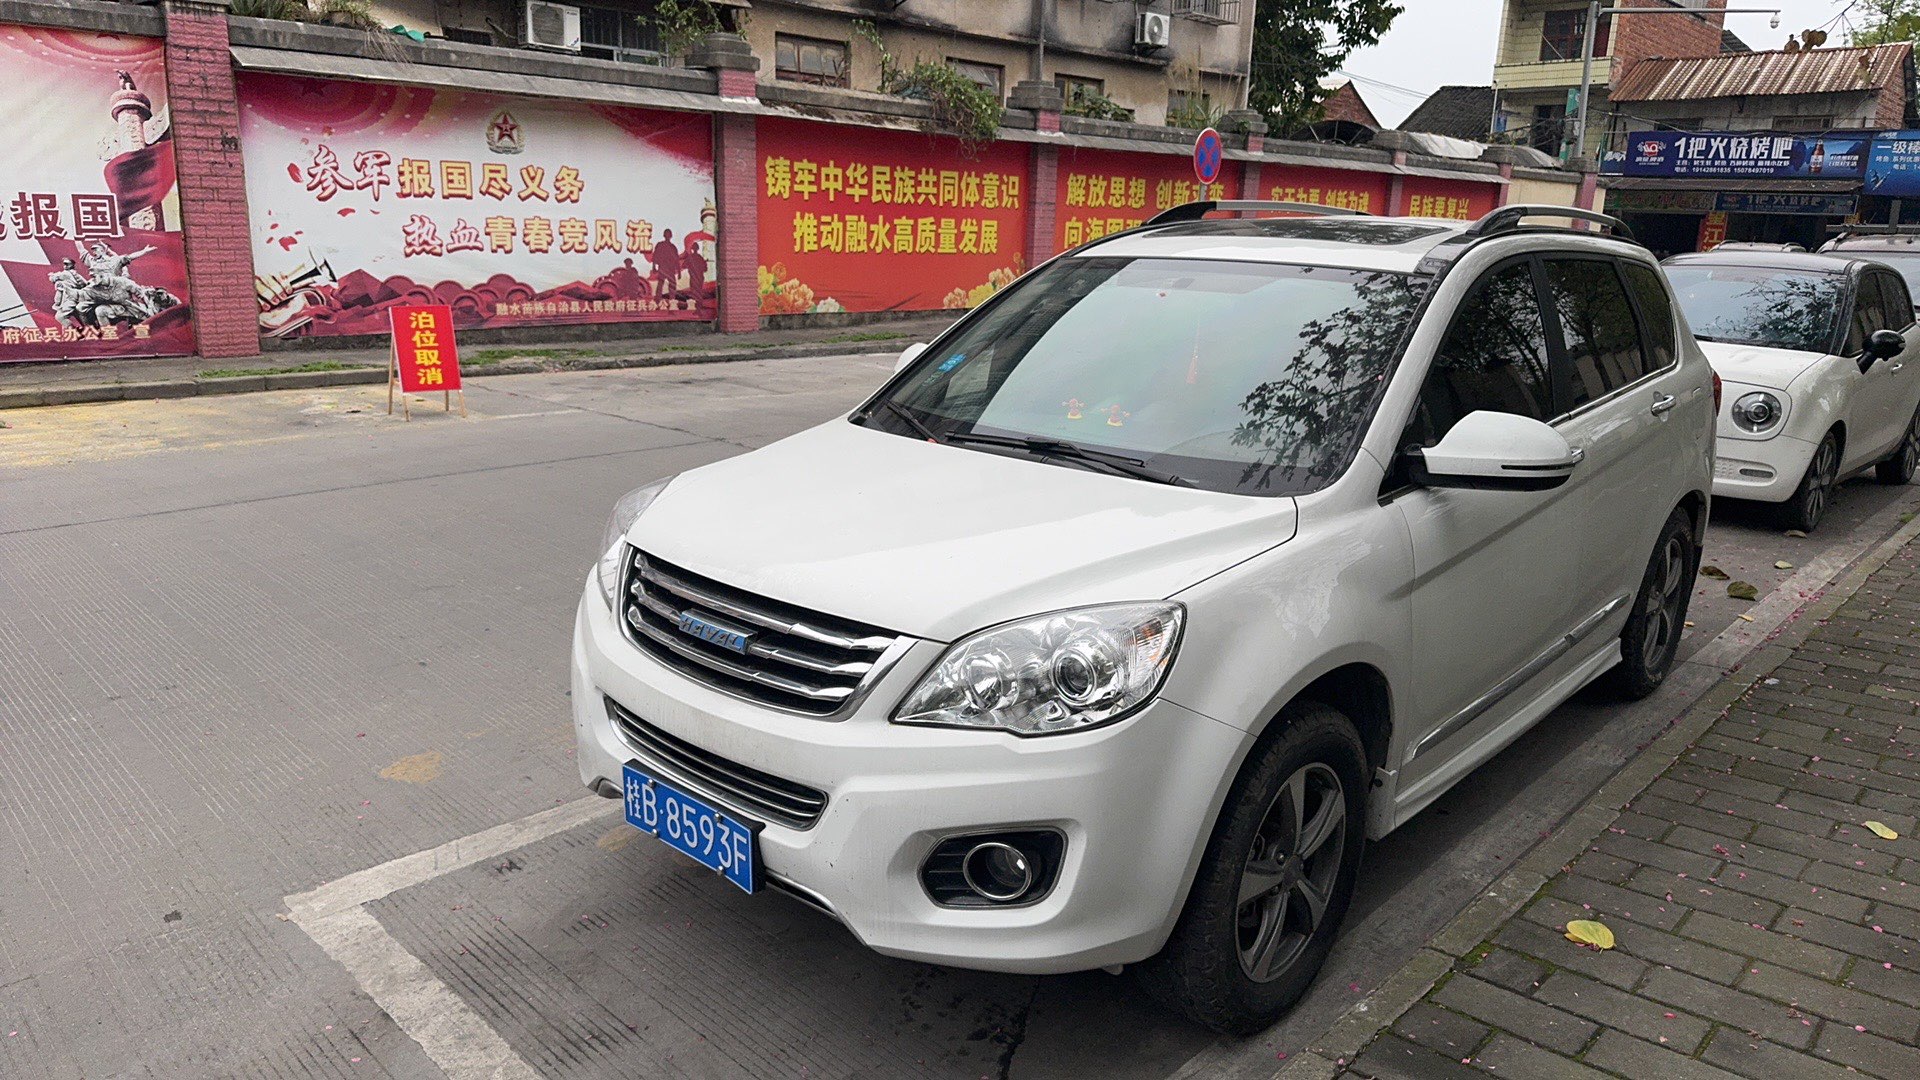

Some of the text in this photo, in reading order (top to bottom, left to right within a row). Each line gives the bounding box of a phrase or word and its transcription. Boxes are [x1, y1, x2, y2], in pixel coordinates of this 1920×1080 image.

[1674, 137, 1793, 159] 1把火烧烤吧
[306, 144, 585, 203] 参军报国尽义务
[764, 155, 1020, 209] 铸牢中华民族共同体意识
[1066, 173, 1146, 210] 解放思想
[0, 191, 123, 240] 报国
[1409, 195, 1470, 220] 民族要复兴
[403, 214, 655, 257] 热血青春竞风流
[793, 211, 998, 254] 推动融水高质量发展
[3, 324, 150, 344] 府征兵办公室 宣
[409, 311, 443, 385] 泊位取消
[680, 616, 742, 651] HAVAL
[626, 777, 748, 875] 桂B·8593F
